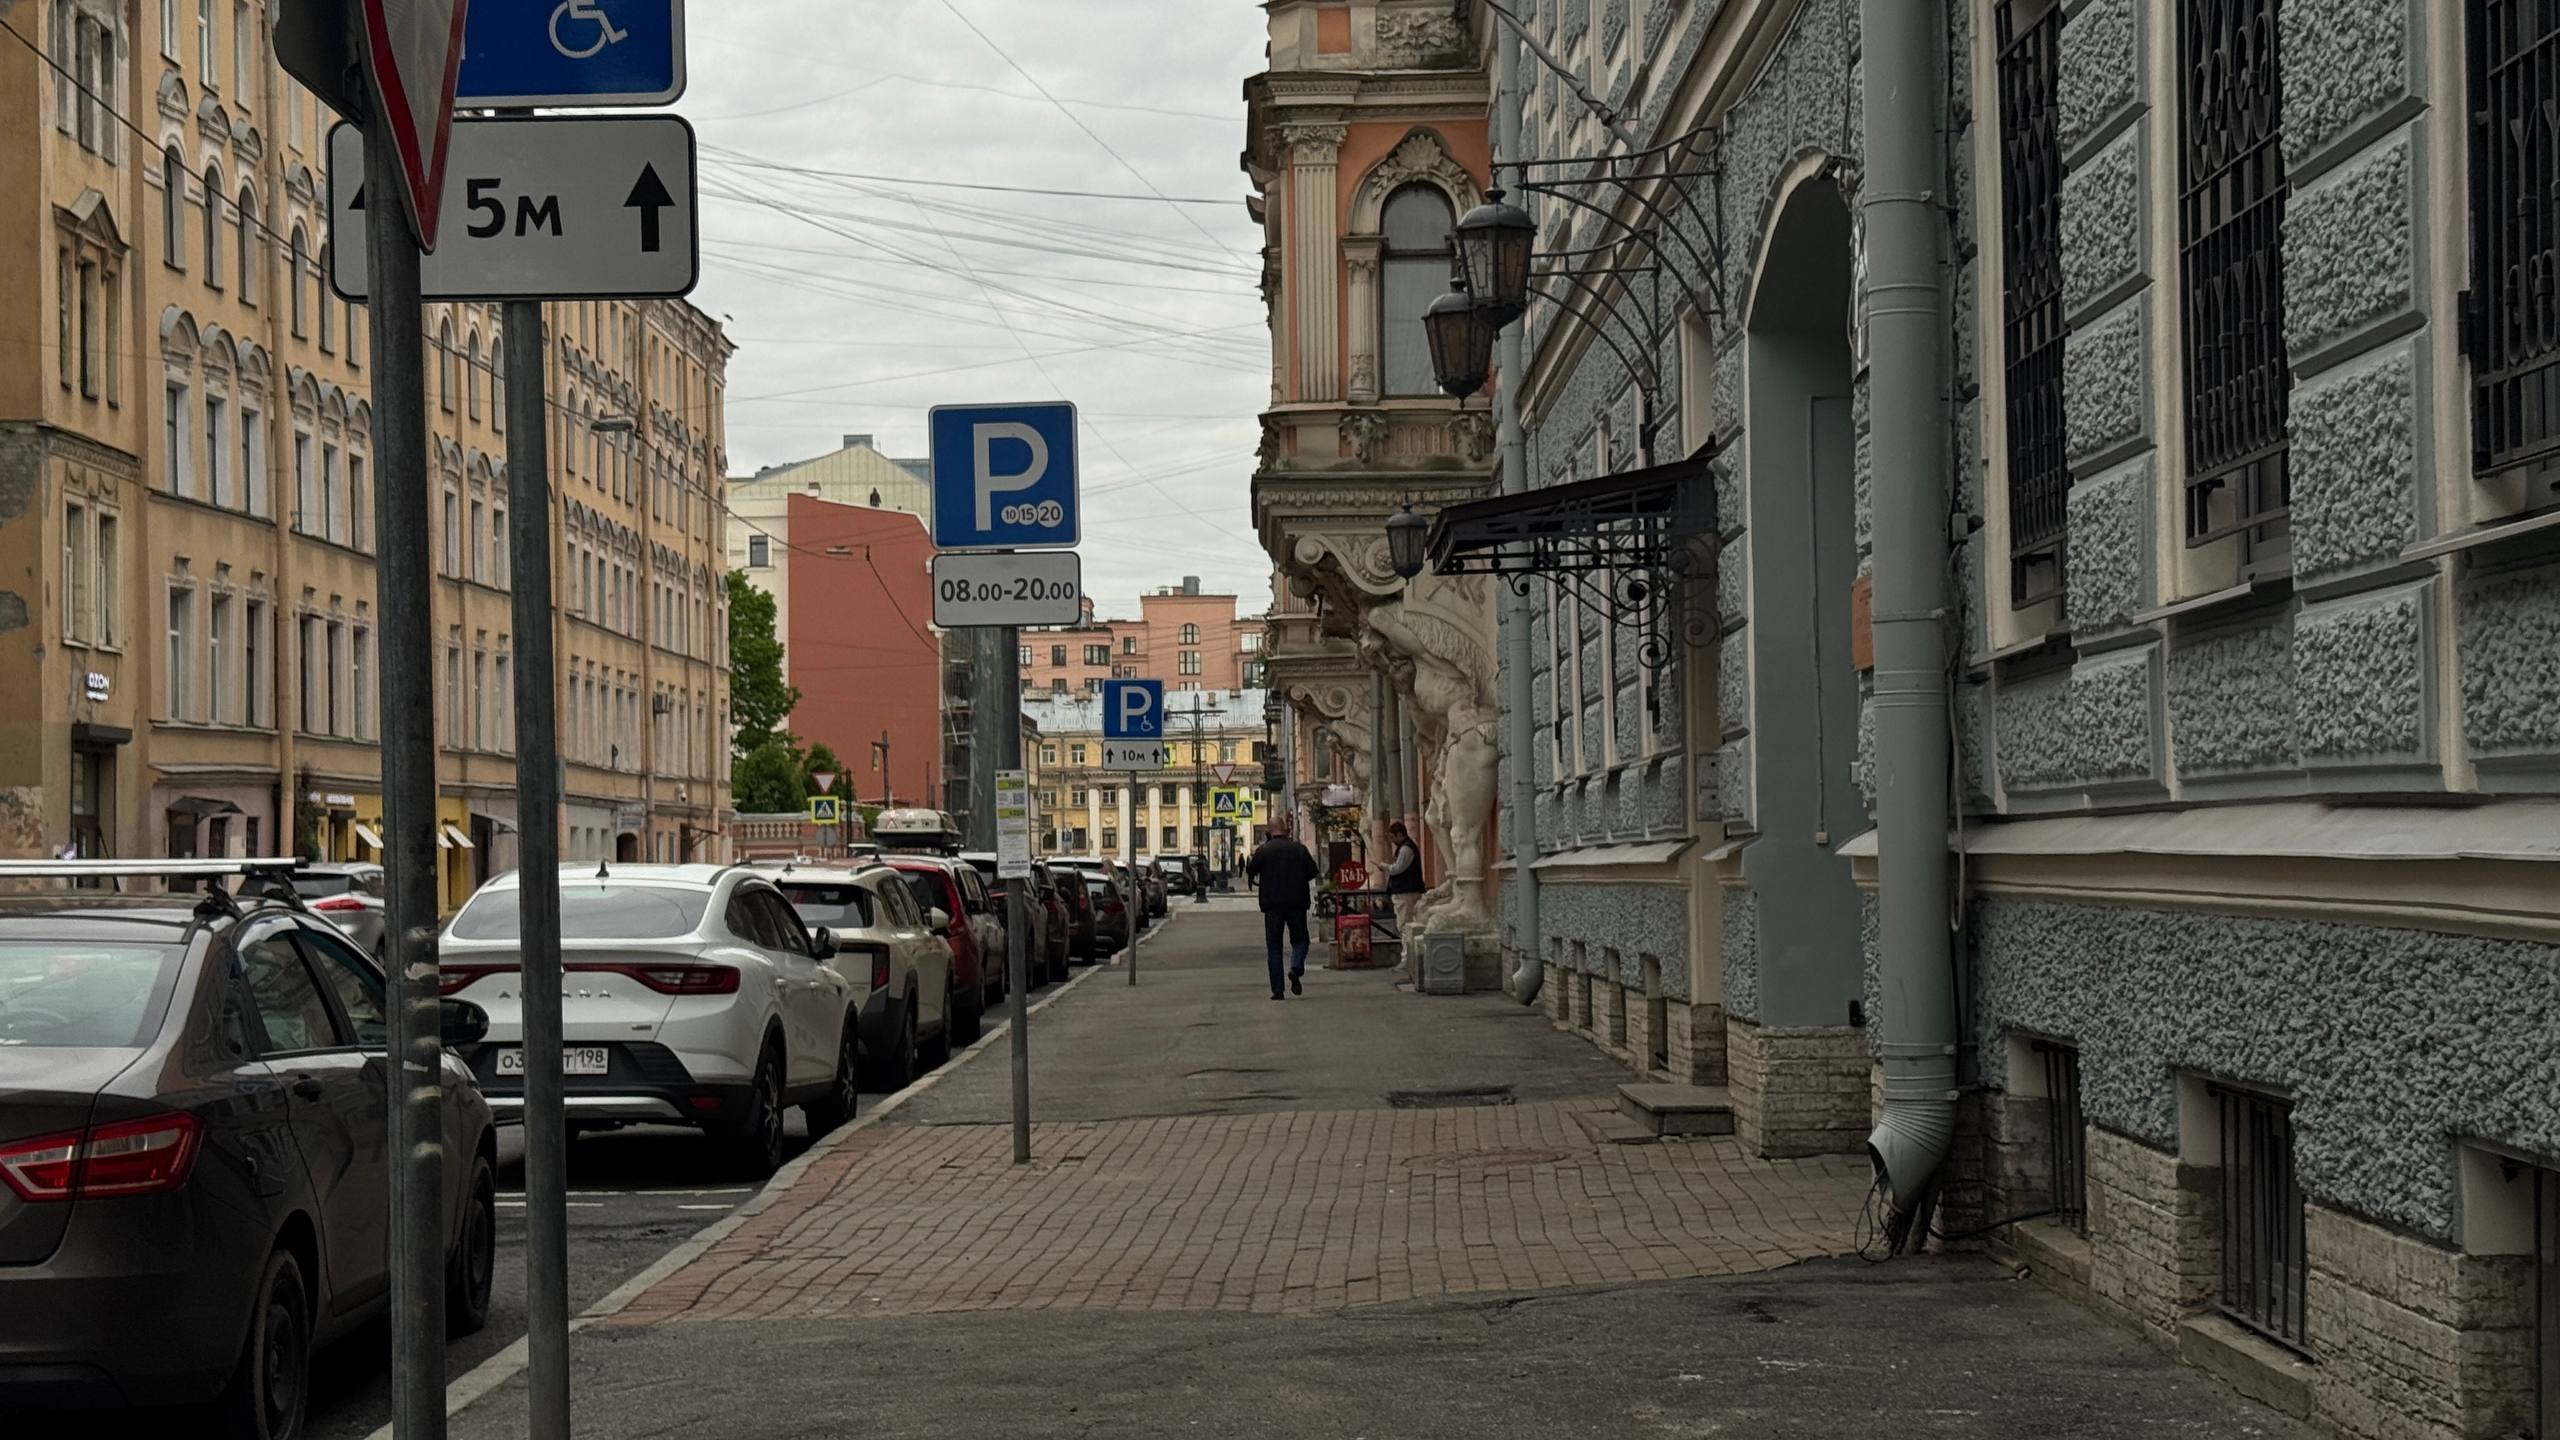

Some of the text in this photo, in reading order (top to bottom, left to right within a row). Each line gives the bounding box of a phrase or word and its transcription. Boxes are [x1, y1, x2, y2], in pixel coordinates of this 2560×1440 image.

[467, 178, 563, 239] 5м
[973, 422, 1048, 531] P
[1004, 506, 1061, 521] 10 15 20
[941, 577, 1075, 602] 08.00-20.00
[88, 672, 110, 689] OZON
[1120, 685, 1152, 732] P
[1122, 749, 1146, 762] 10м
[499, 989, 612, 999] AANA
[502, 1049, 605, 1069] О3Т 198
